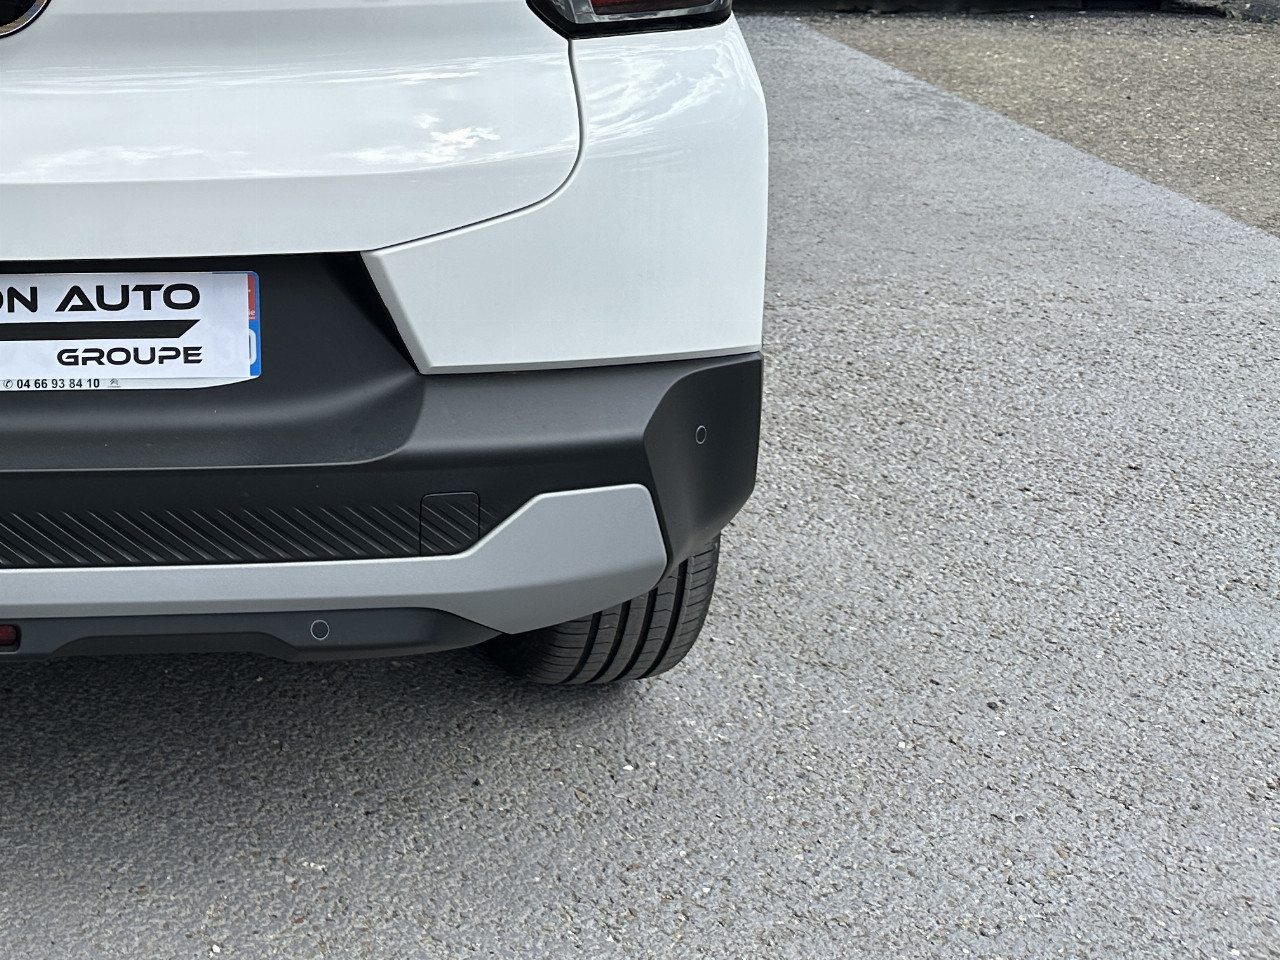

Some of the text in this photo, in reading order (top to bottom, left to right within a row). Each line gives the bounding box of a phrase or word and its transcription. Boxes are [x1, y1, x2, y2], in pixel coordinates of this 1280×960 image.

[56, 283, 201, 312] AUTO
[56, 346, 203, 367] GROUPE
[16, 378, 31, 389] 04
[34, 378, 48, 389] 66
[51, 378, 65, 389] 93
[69, 378, 83, 389] 84
[86, 378, 100, 389] 10
